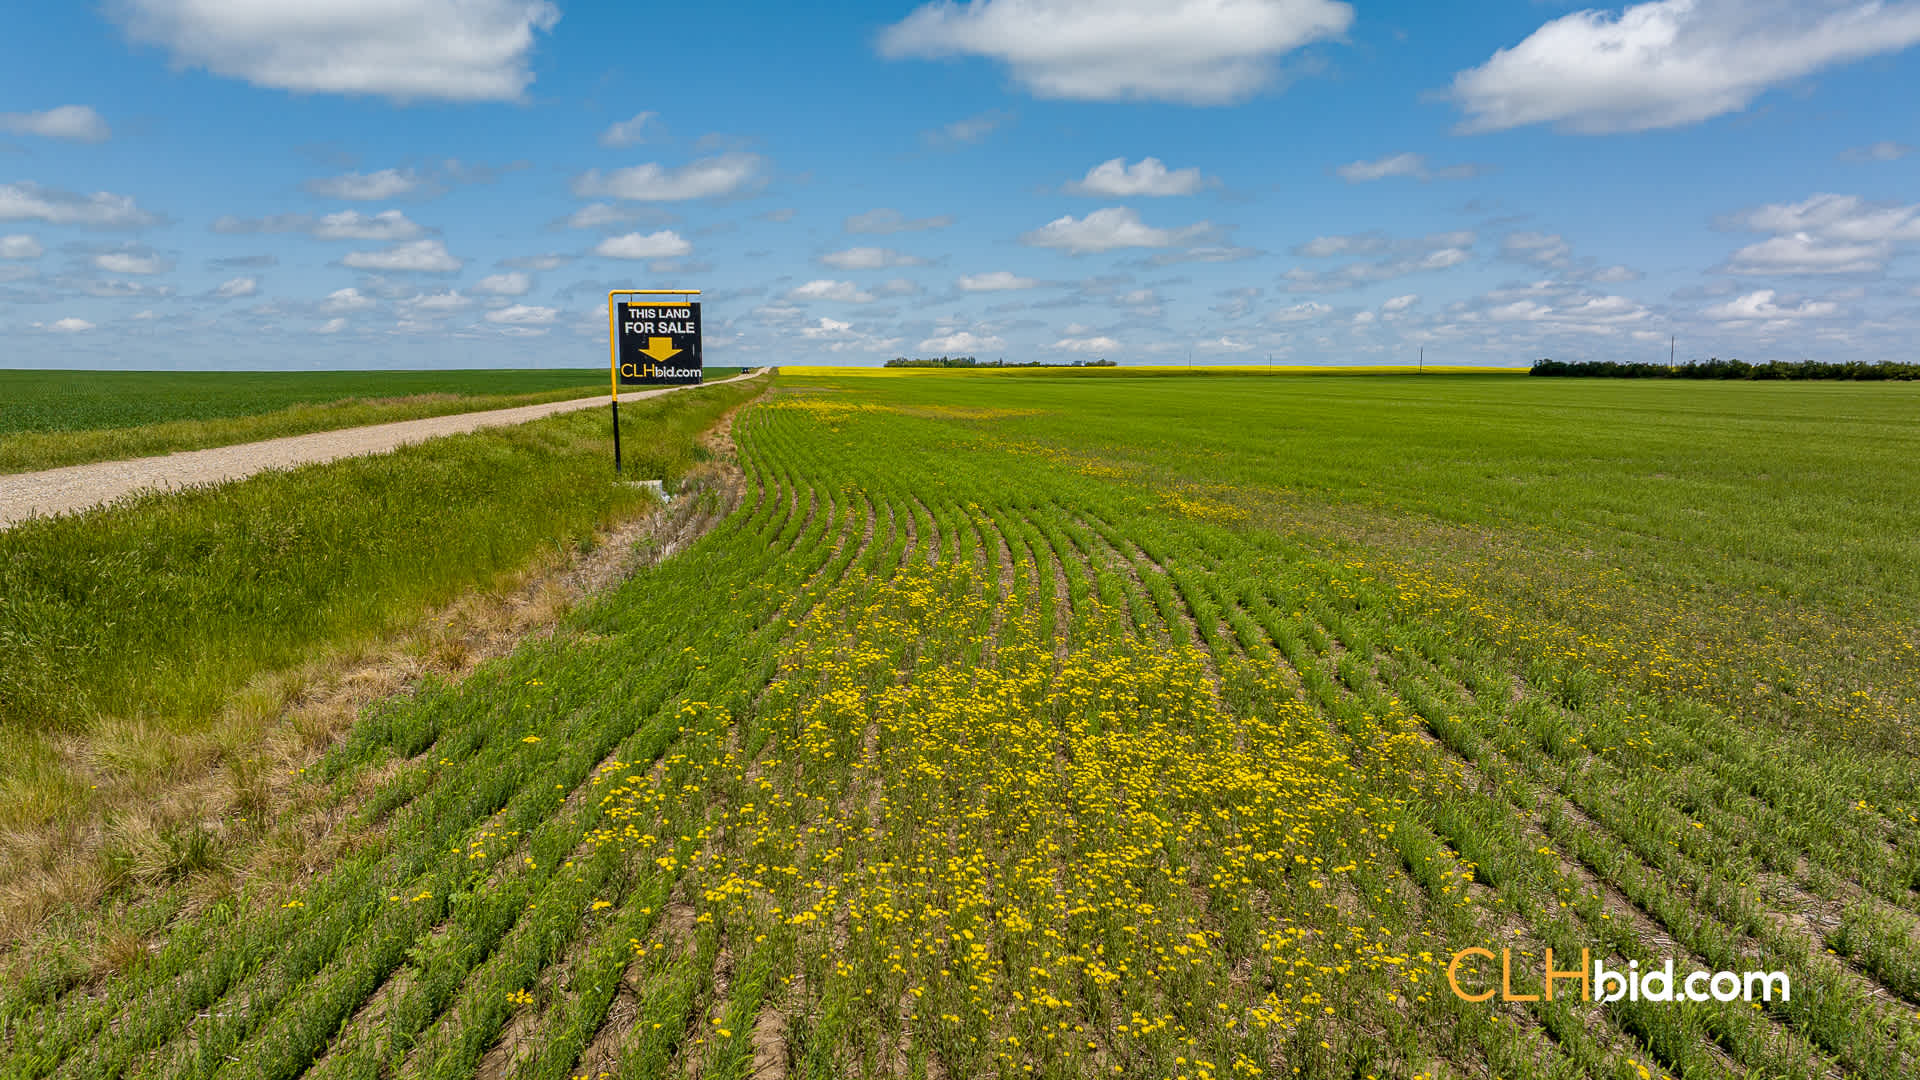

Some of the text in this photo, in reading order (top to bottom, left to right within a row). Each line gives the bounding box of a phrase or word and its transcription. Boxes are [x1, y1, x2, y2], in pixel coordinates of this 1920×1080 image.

[628, 308, 691, 319] THIS LAND
[624, 321, 695, 334] FOR SALE
[620, 362, 702, 378] CLHbid.com
